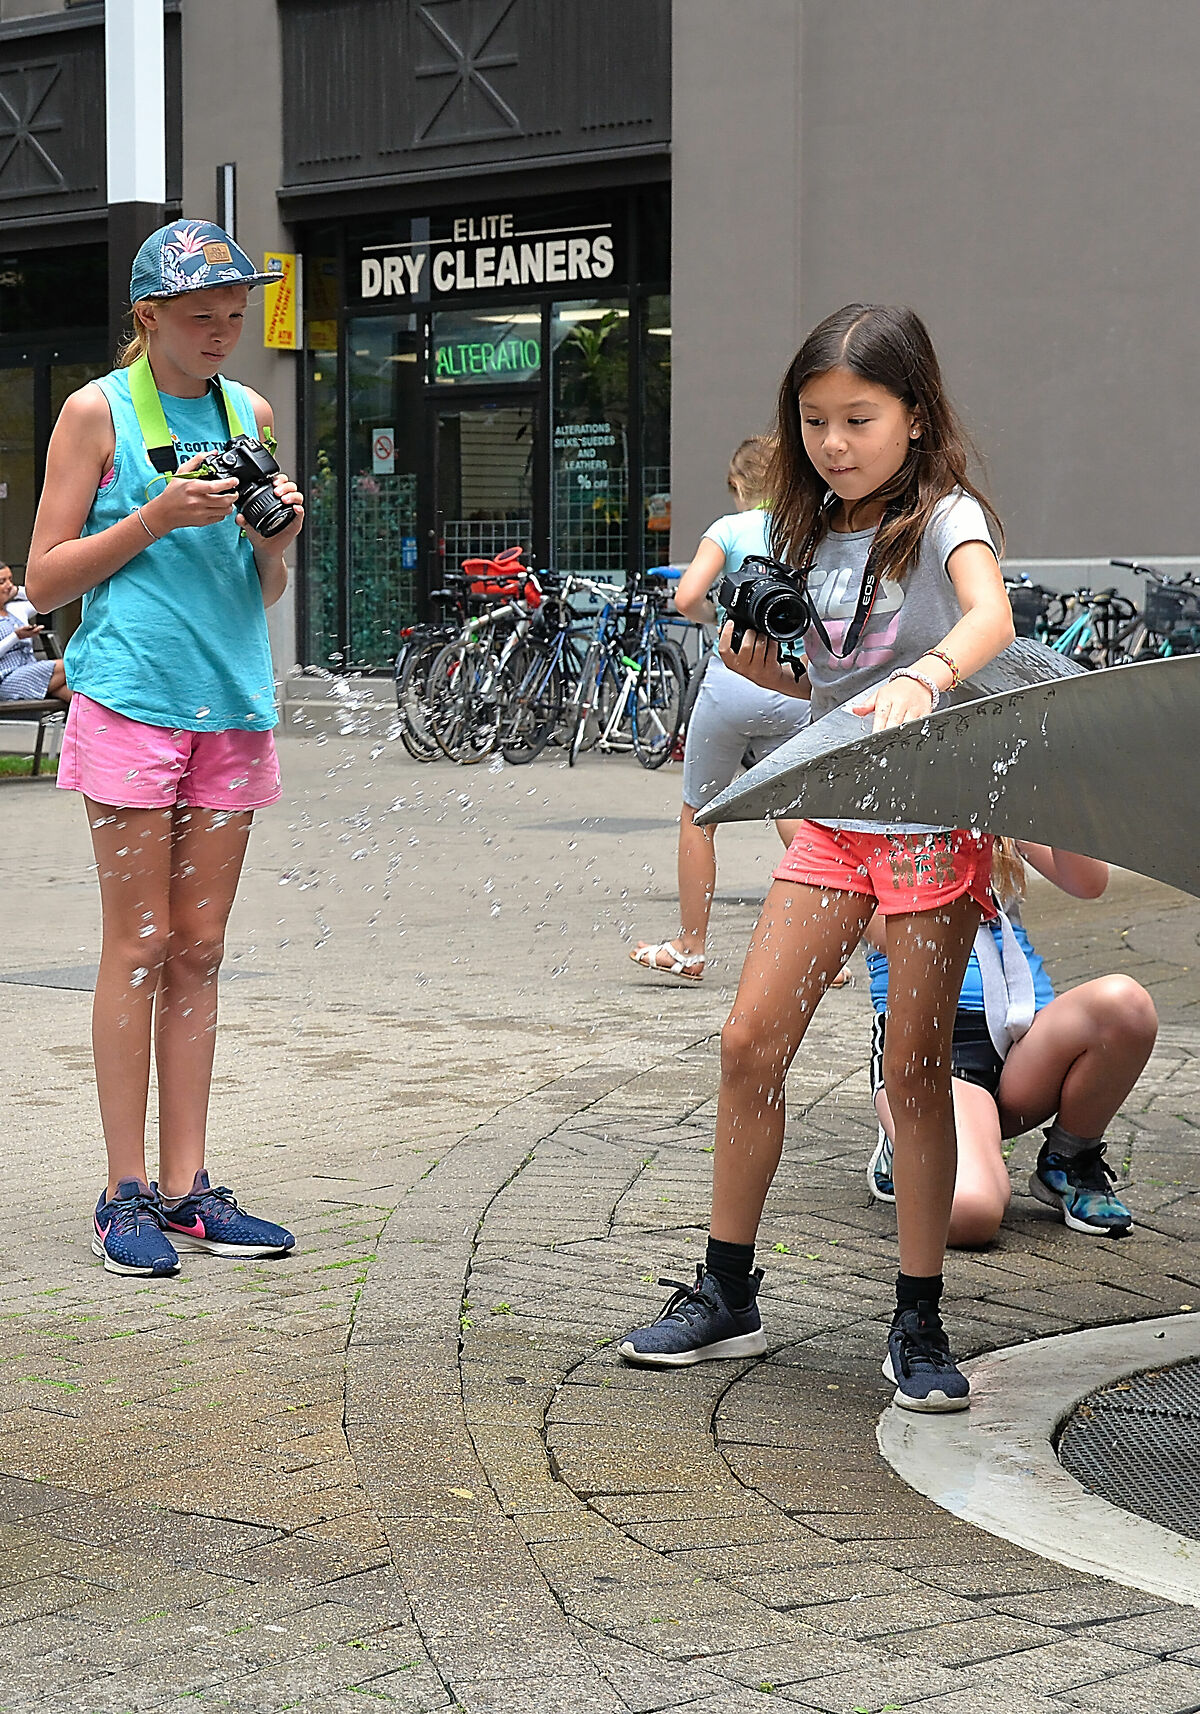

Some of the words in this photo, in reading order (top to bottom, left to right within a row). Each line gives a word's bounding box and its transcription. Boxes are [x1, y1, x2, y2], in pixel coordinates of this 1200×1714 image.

[453, 213, 514, 243] ELITE
[361, 253, 426, 298] DRY
[432, 235, 615, 292] CLEANERS
[436, 339, 540, 376] ALTERATIO
[555, 422, 611, 436] ALTERATIONS
[184, 441, 209, 453] GOT
[581, 435, 616, 447] SUEDES
[577, 448, 596, 459] AND
[564, 459, 608, 472] LEATHERS
[593, 479, 609, 489] OFF
[730, 587, 741, 607] Canon
[862, 574, 875, 606] EOS
